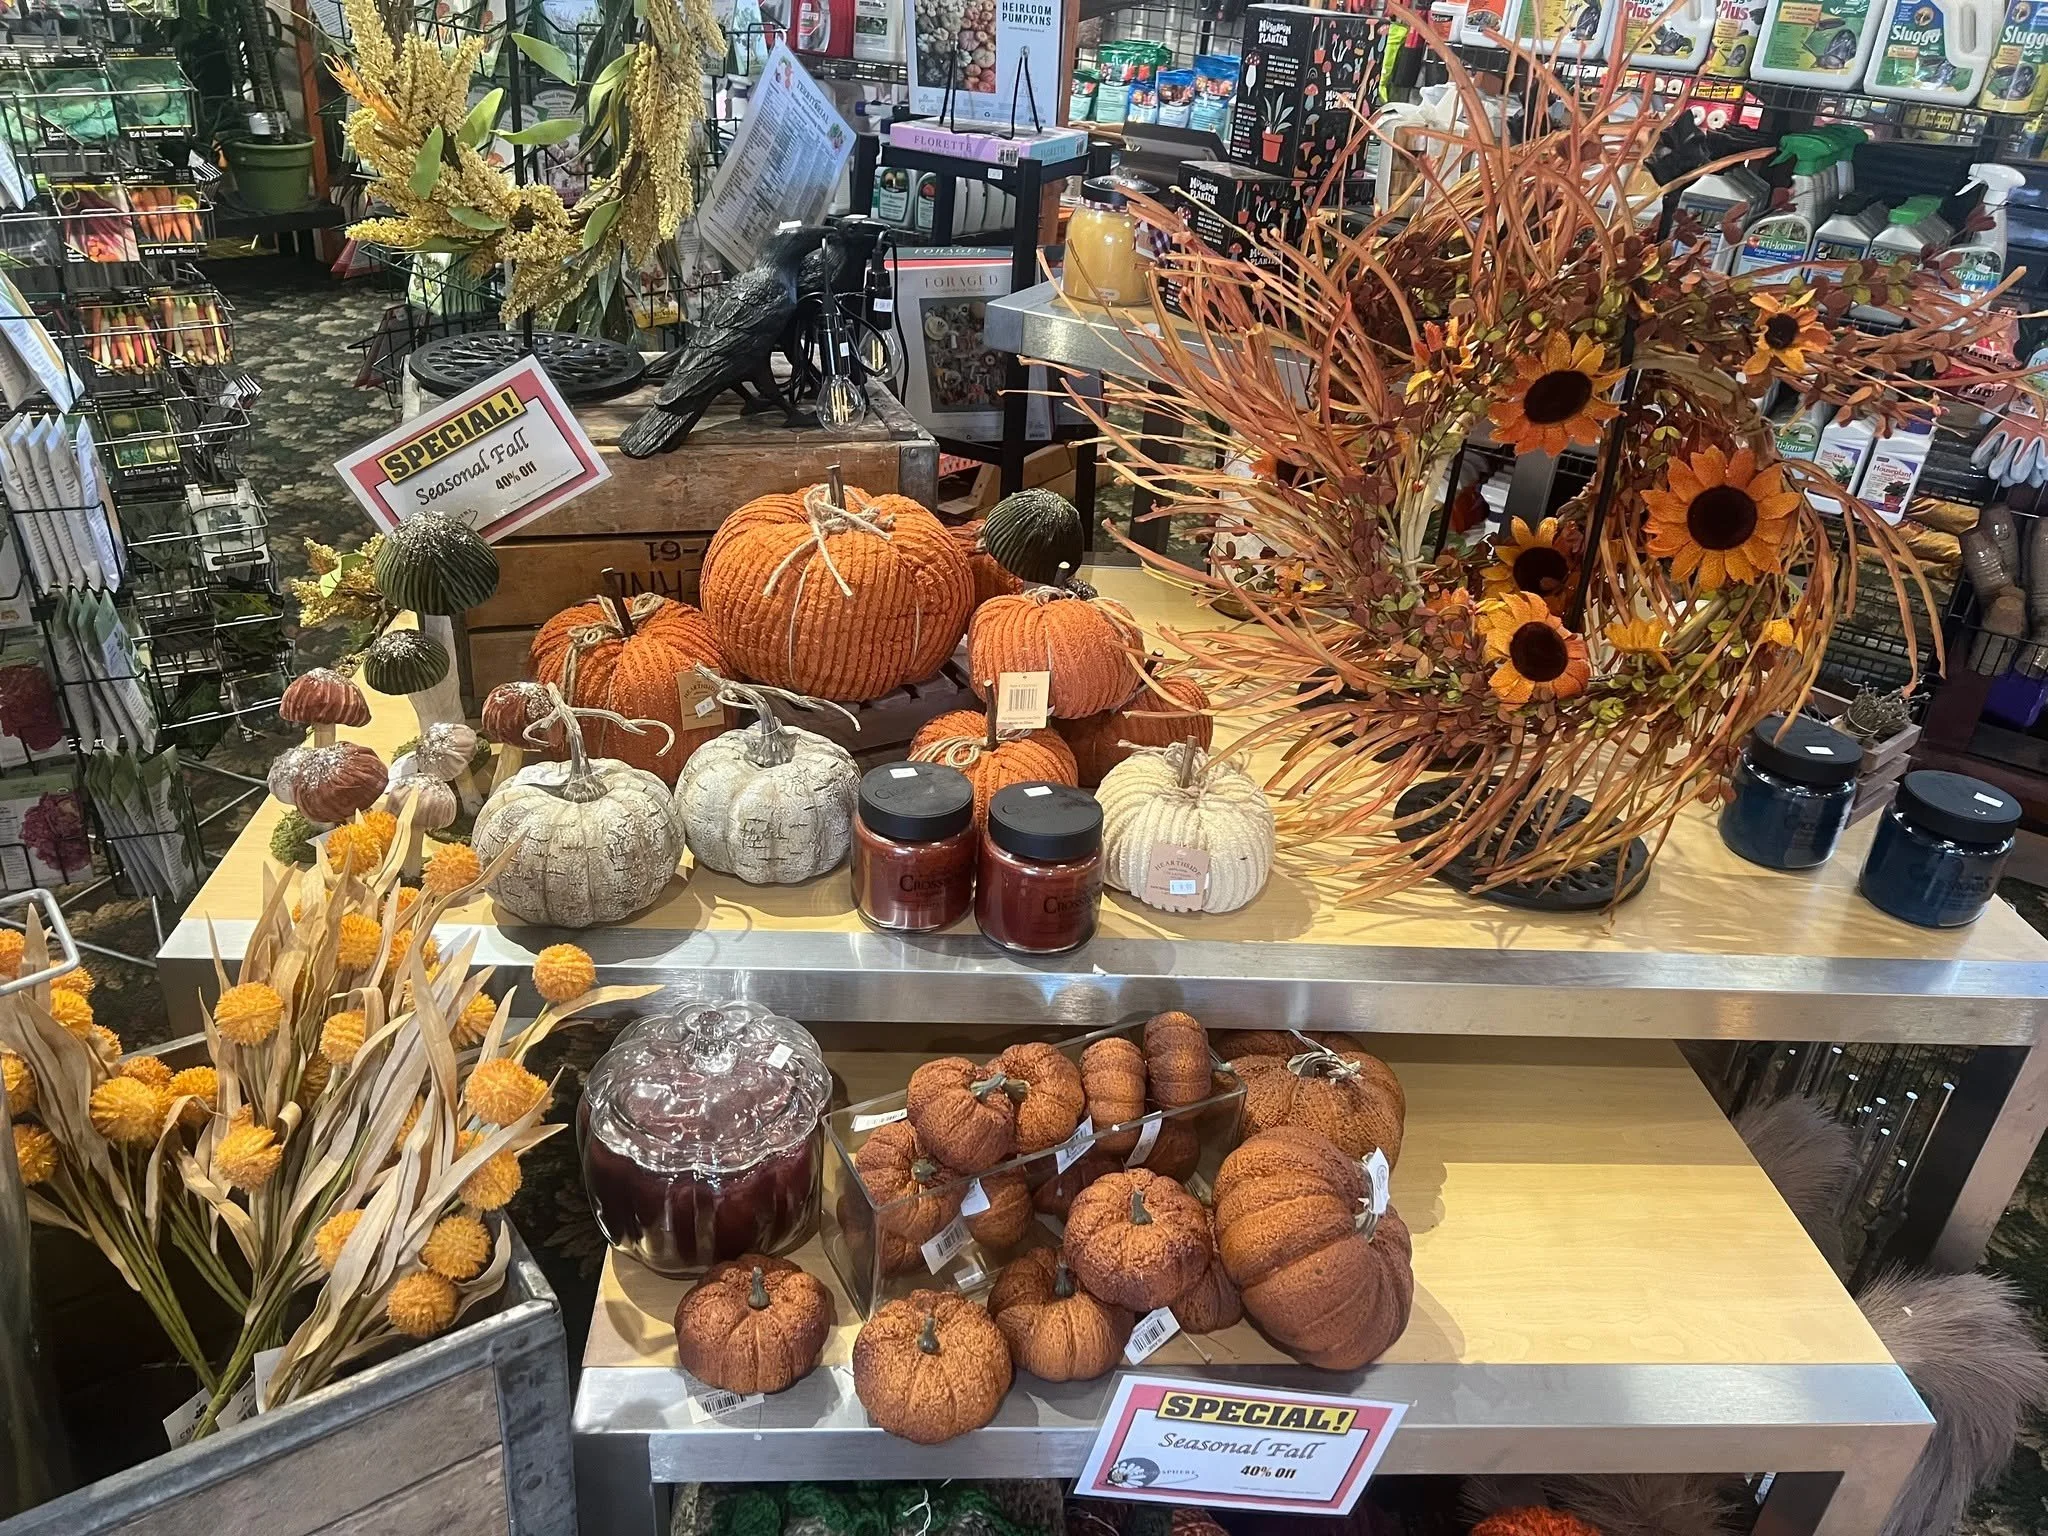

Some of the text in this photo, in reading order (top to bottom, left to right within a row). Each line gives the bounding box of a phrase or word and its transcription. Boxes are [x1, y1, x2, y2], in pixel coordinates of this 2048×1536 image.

[1002, 2, 1052, 15] HEIRLOOM
[1719, 0, 1749, 20] Plus
[1002, 13, 1052, 26] PUMPKINS
[1259, 19, 1291, 35] MUSHROOM
[1258, 32, 1288, 47] PLANTER
[1890, 25, 1942, 46] Sluggo
[797, 80, 830, 124] TERRITORIAL
[914, 135, 973, 151] FLORETTE
[1189, 177, 1218, 195] MUSHROOM
[1190, 190, 1216, 205] PLANTER
[144, 248, 155, 256] Ed
[924, 275, 998, 289] FORAGED
[384, 391, 519, 479] SPECIAL!
[416, 448, 490, 506] Seasonal
[491, 426, 530, 466] Fall
[1873, 464, 1912, 480] Houseplant
[496, 470, 520, 491] 40%
[519, 460, 538, 479] Off
[1154, 860, 1202, 877] HEARTHSIDE
[1164, 1394, 1350, 1432] SPECIAL!
[1158, 1432, 1326, 1461] Seasonal Fall
[1240, 1465, 1297, 1480] 40% Off
